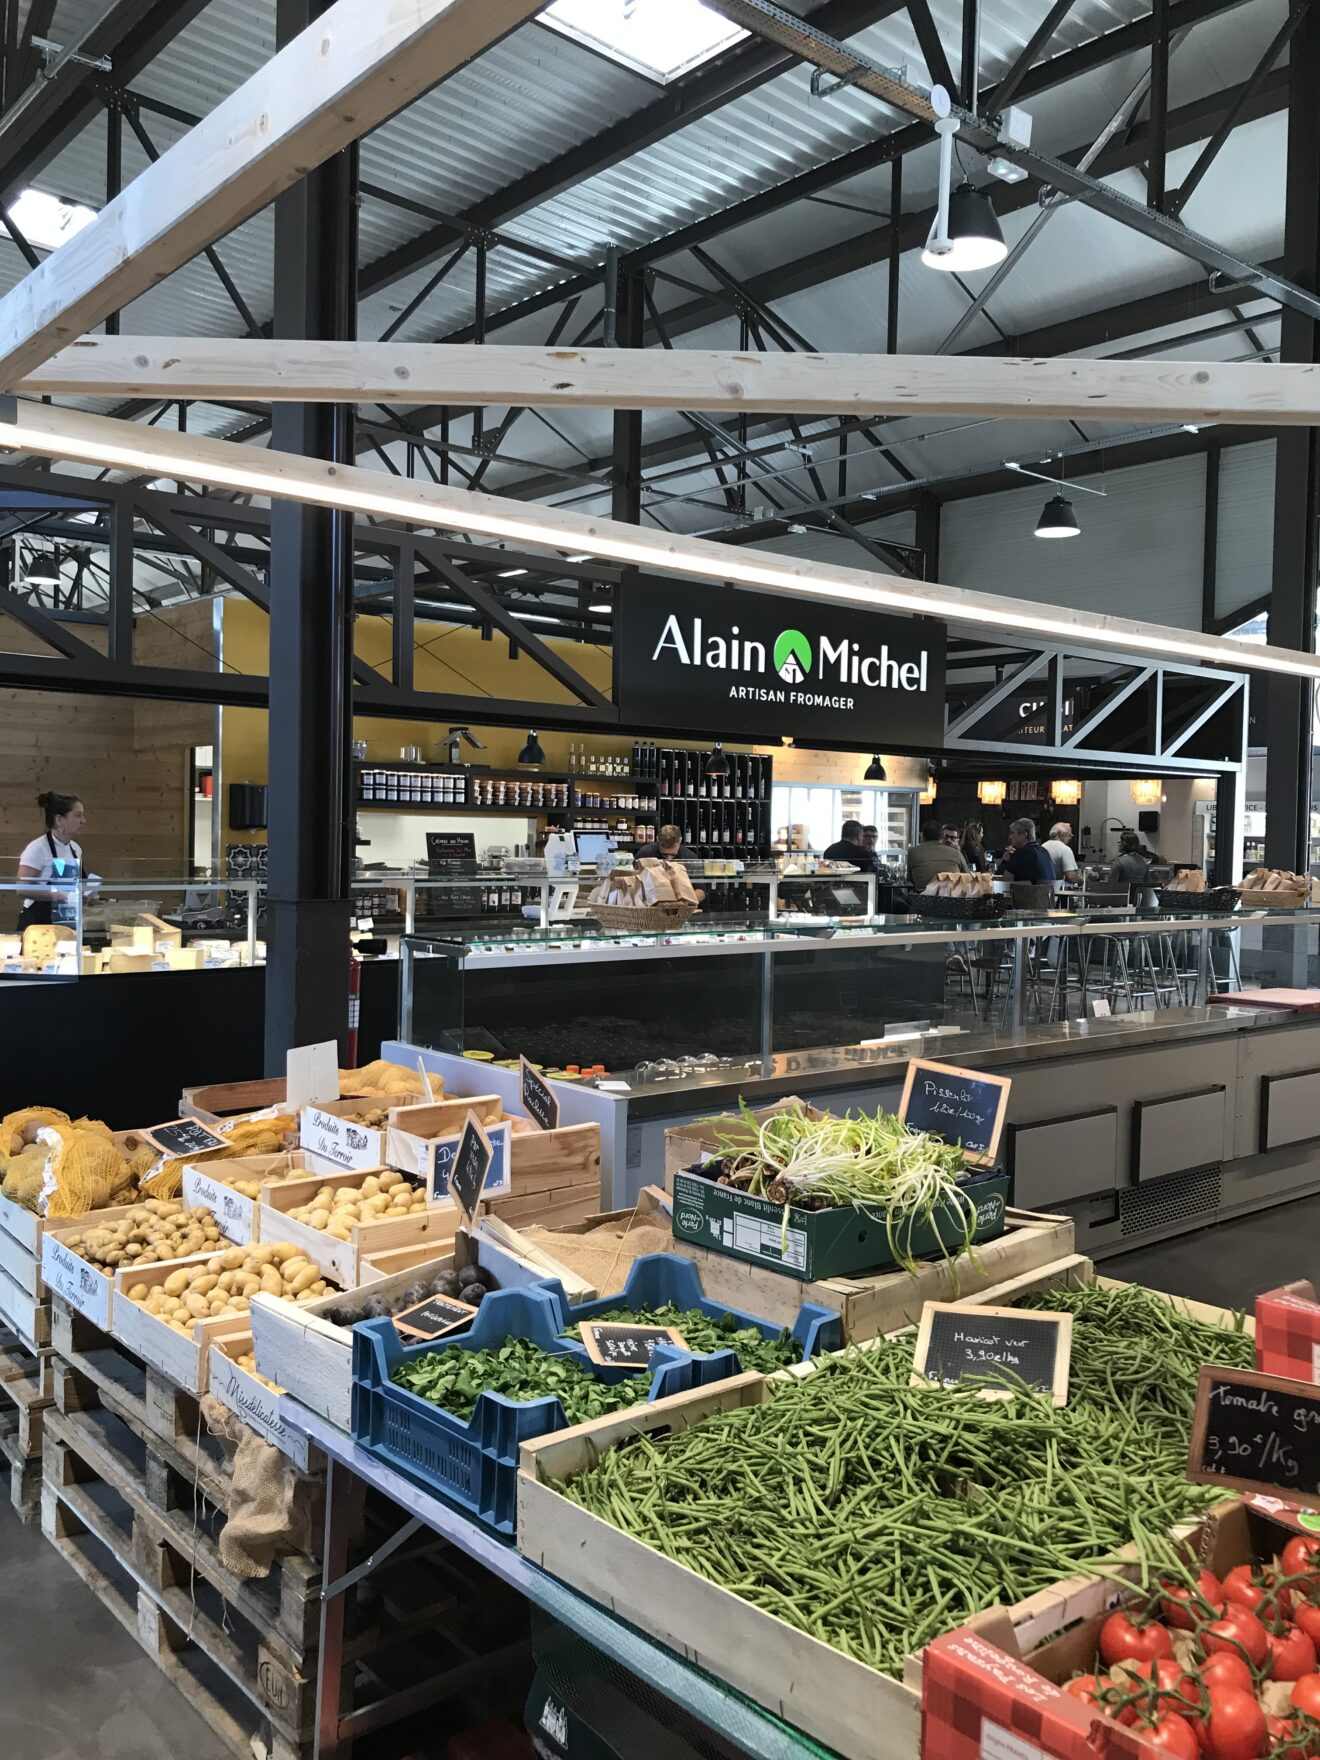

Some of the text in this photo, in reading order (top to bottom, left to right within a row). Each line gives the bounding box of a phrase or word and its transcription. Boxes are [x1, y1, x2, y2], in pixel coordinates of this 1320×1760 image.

[652, 614, 928, 692] Alain Michel
[728, 685, 854, 709] ARTISAN FROMAGER
[312, 1112, 340, 1136] Produits
[317, 1136, 353, 1164] Du Terroir
[193, 1177, 217, 1203] Produits
[713, 1188, 733, 1202] France
[733, 1195, 743, 1204] de
[745, 1198, 762, 1210] Blanc
[681, 1219, 699, 1230] Perle
[51, 1244, 75, 1274] Produits
[64, 1280, 85, 1307] Terroir
[954, 1331, 1001, 1345] Haricot
[265, 1667, 283, 1703] EUR
